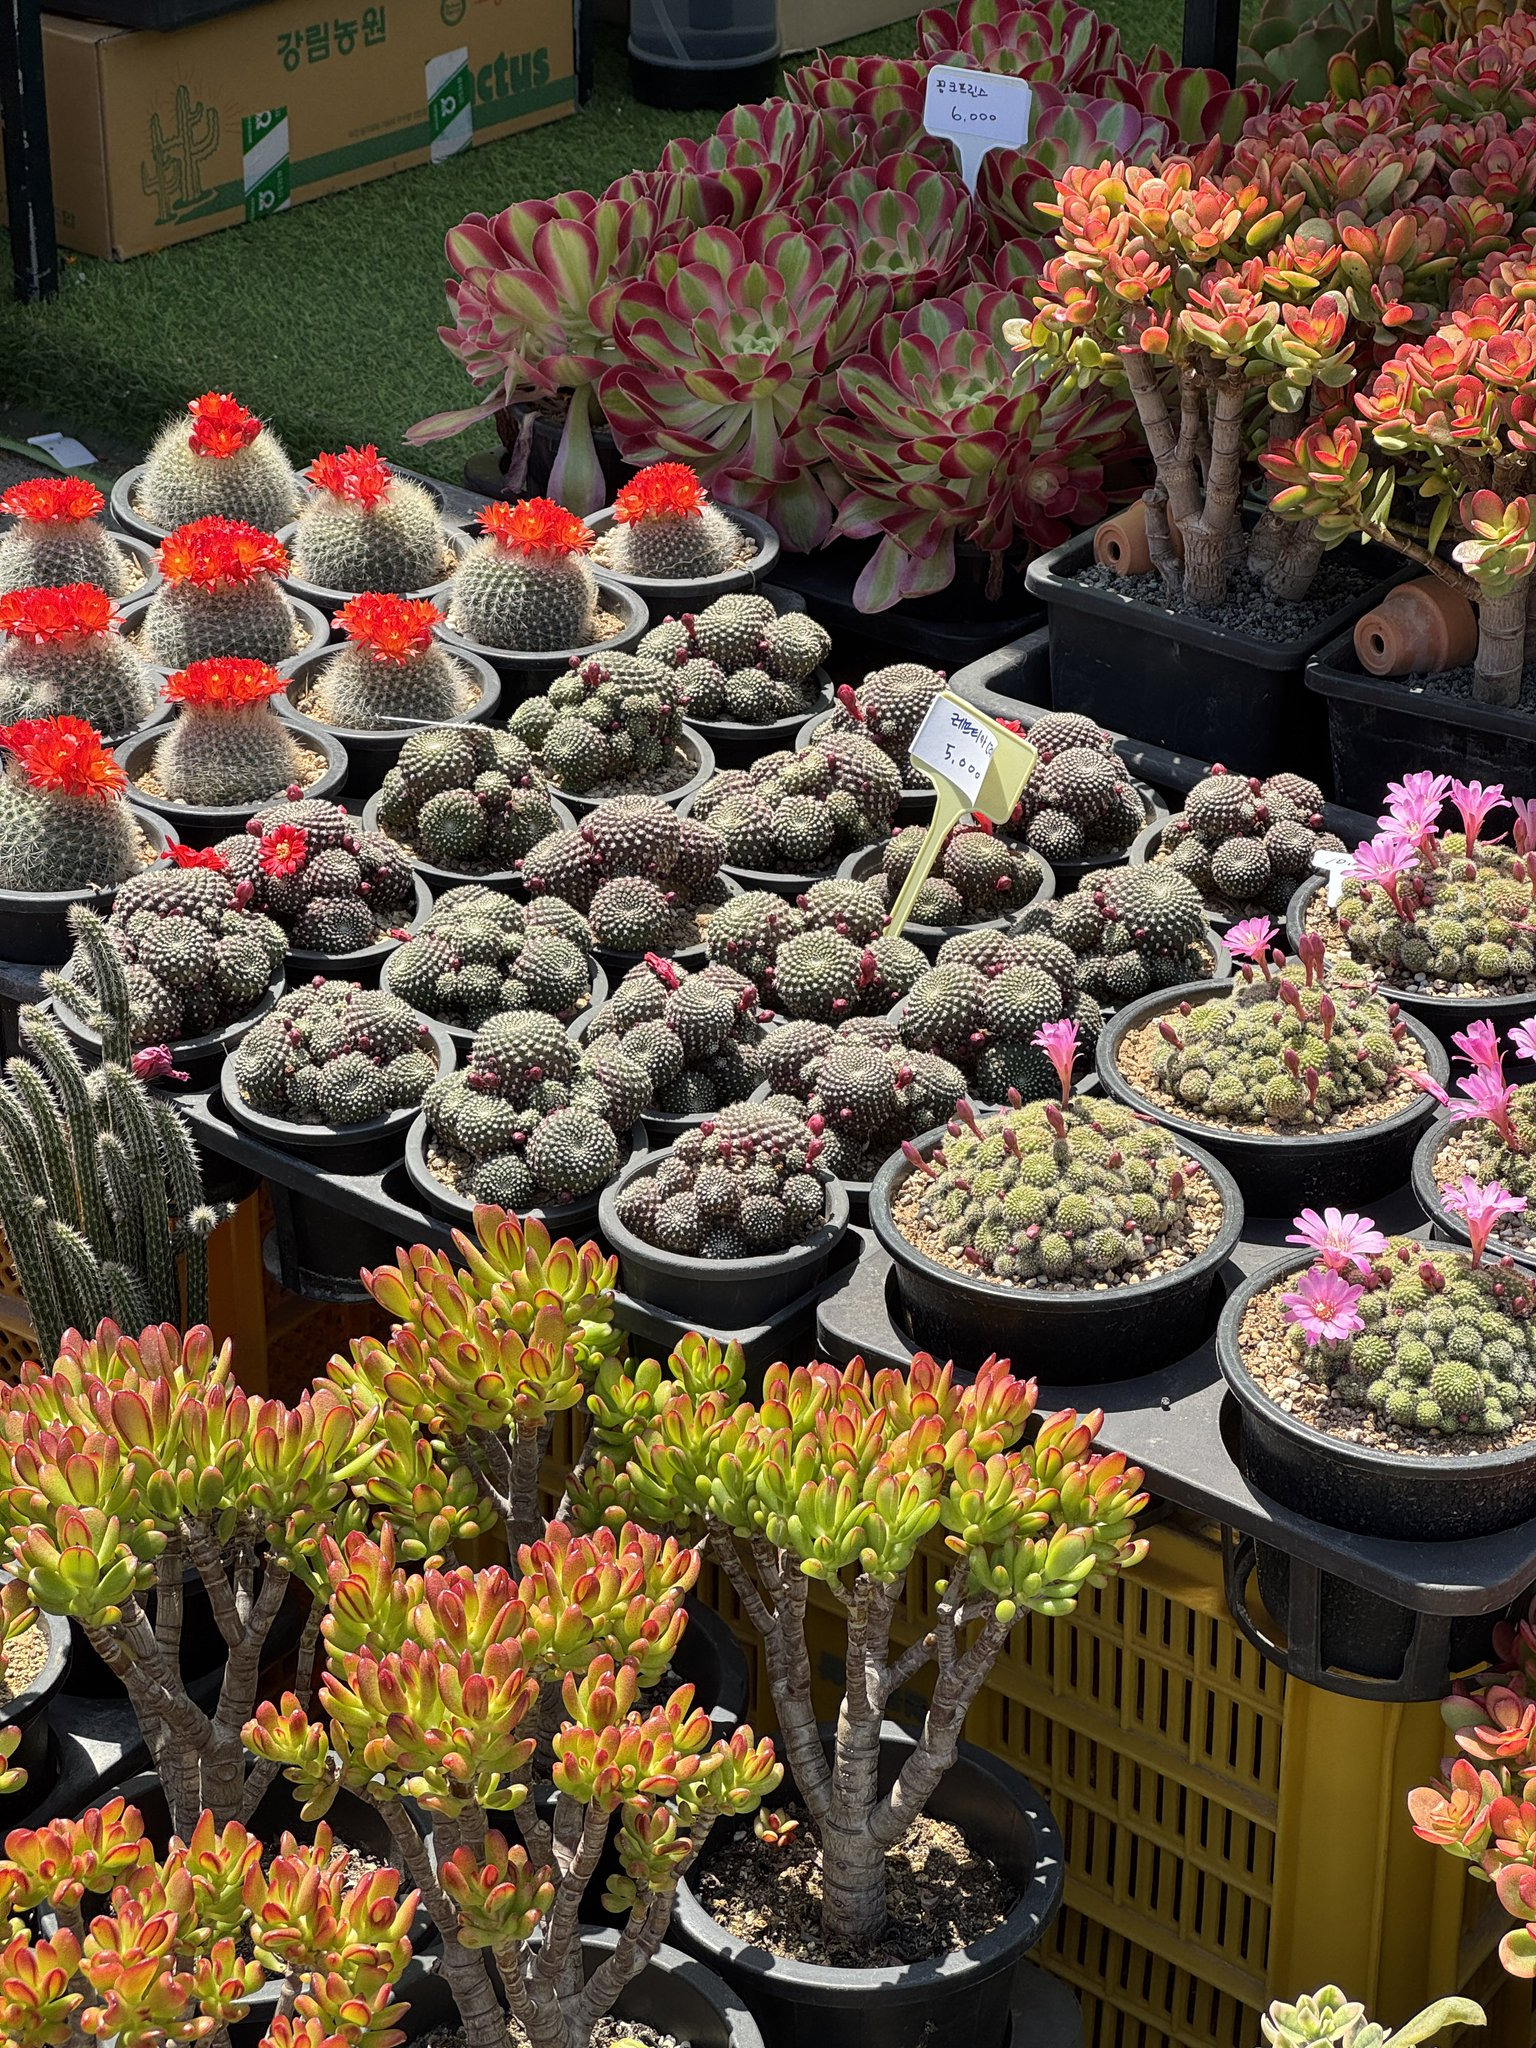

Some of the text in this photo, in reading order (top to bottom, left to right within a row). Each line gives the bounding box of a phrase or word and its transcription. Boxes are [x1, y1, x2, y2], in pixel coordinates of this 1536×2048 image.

[277, 5, 386, 72] 강림농원
[468, 47, 550, 106] ctus
[951, 105, 997, 122] 6,000
[944, 743, 981, 780] 5,000
